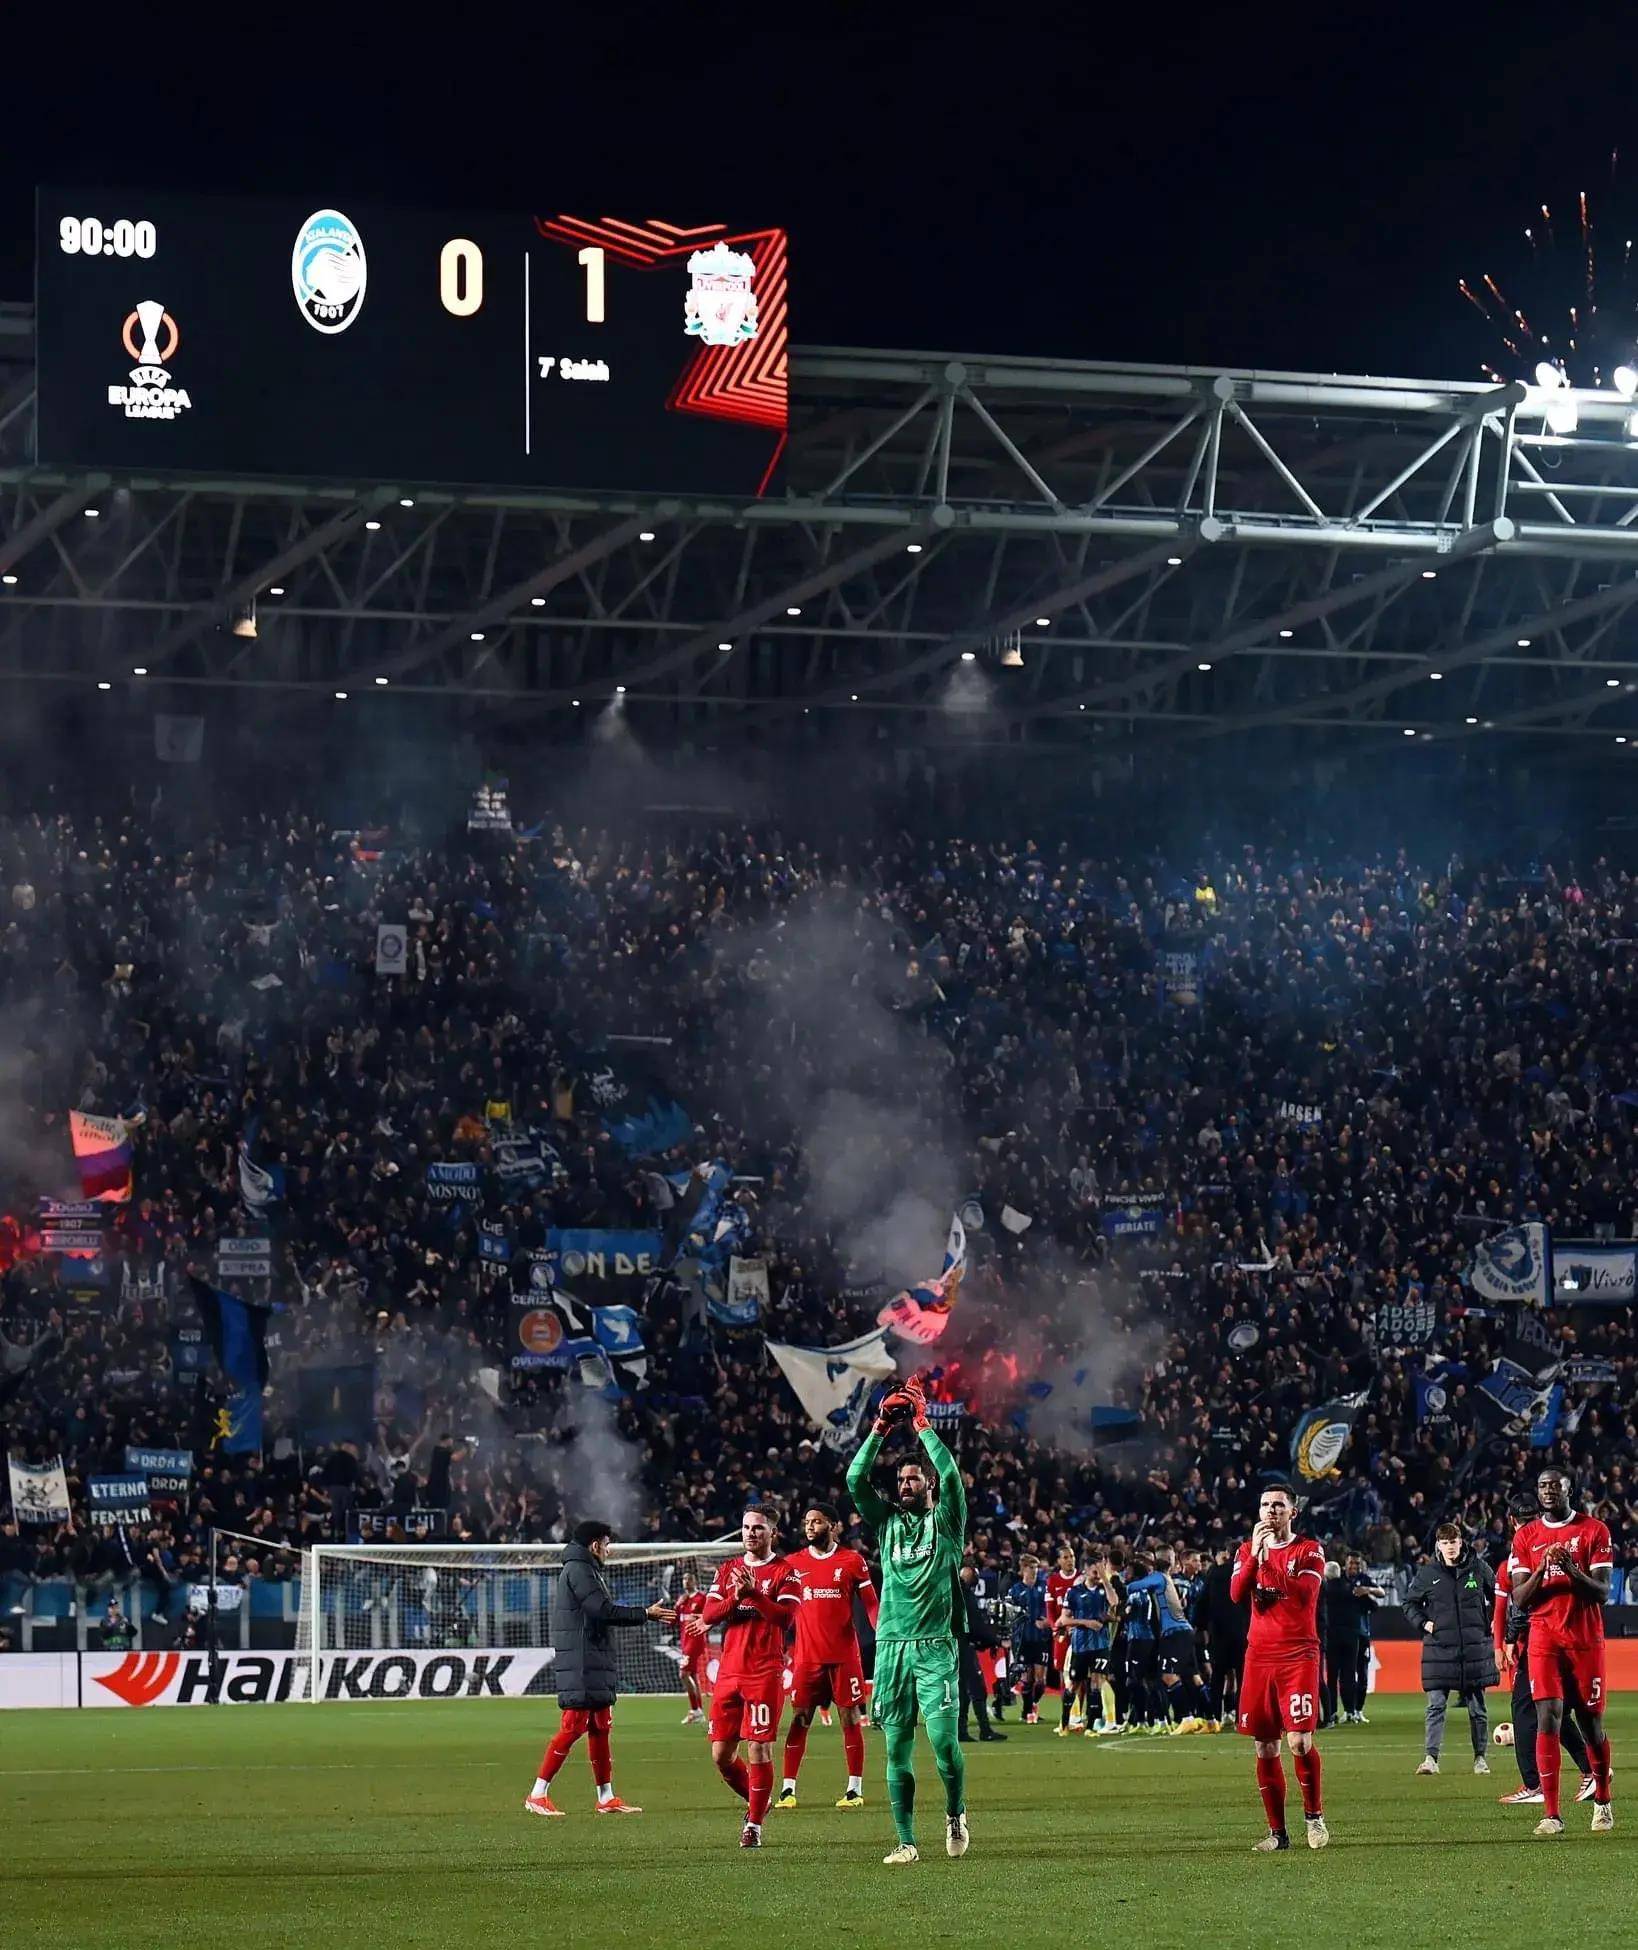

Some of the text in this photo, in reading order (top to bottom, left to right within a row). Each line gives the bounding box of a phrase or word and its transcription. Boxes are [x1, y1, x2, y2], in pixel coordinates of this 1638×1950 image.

[59, 216, 156, 258] 90:00
[440, 238, 484, 316] 0
[579, 246, 605, 322] 1
[560, 357, 610, 381] Salah
[108, 385, 192, 408] EUROPA
[91, 1480, 148, 1499] ETERNA
[813, 1587, 840, 1595] standard
[1094, 1658, 1108, 1671] 77
[849, 1677, 861, 1695] 2
[943, 1679, 952, 1703] 1
[1592, 1677, 1601, 1699] 5
[750, 1703, 770, 1727] 10
[1289, 1693, 1312, 1717] 26
